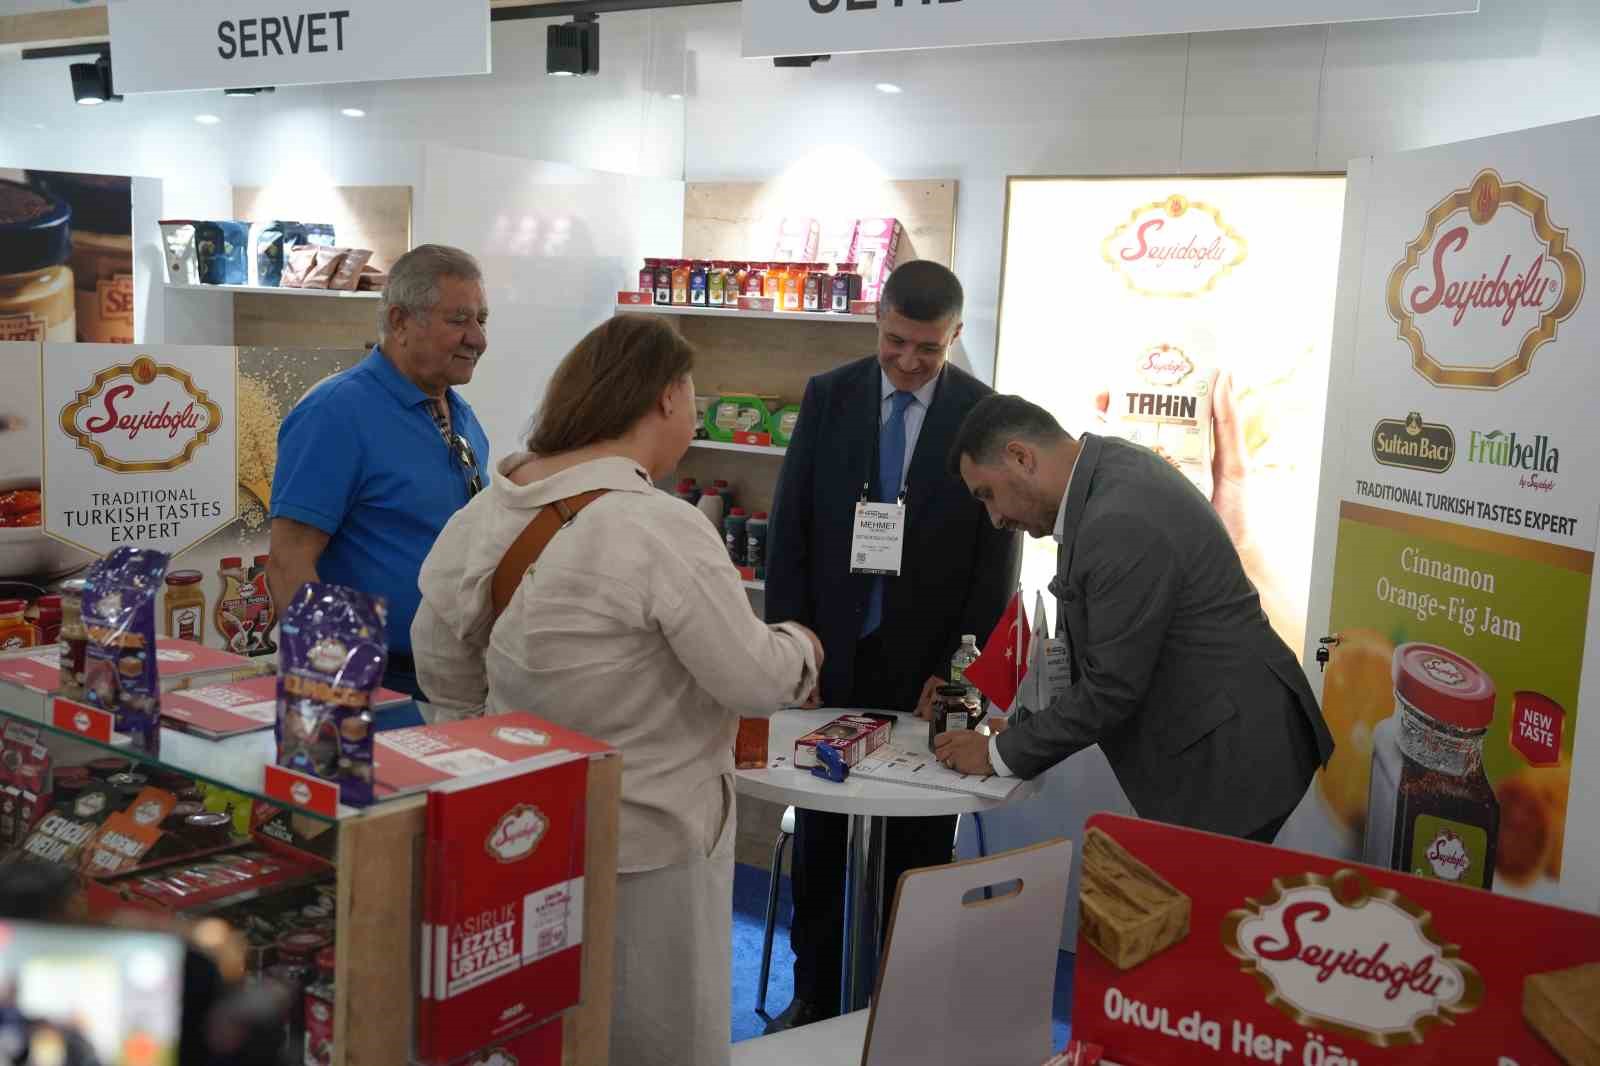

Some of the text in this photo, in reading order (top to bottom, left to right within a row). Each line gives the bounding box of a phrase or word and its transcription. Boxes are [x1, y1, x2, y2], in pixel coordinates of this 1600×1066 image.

[217, 10, 350, 60] SERVET
[1376, 431, 1419, 458] Sultan
[63, 501, 222, 528] TURKISH TASTES
[92, 488, 197, 507] TRADITIONAL
[1355, 480, 1578, 537] TRADITIONAL TURKISH TASTES EXPERT
[110, 521, 182, 543] EXPERT
[1400, 546, 1496, 594] Cinnamon
[1376, 576, 1521, 642] Orange-Fig Jam
[1519, 721, 1554, 748] TASTE
[1523, 708, 1553, 730] NEW
[450, 919, 515, 961] LEZZET
[1231, 1018, 1293, 1065] Her
